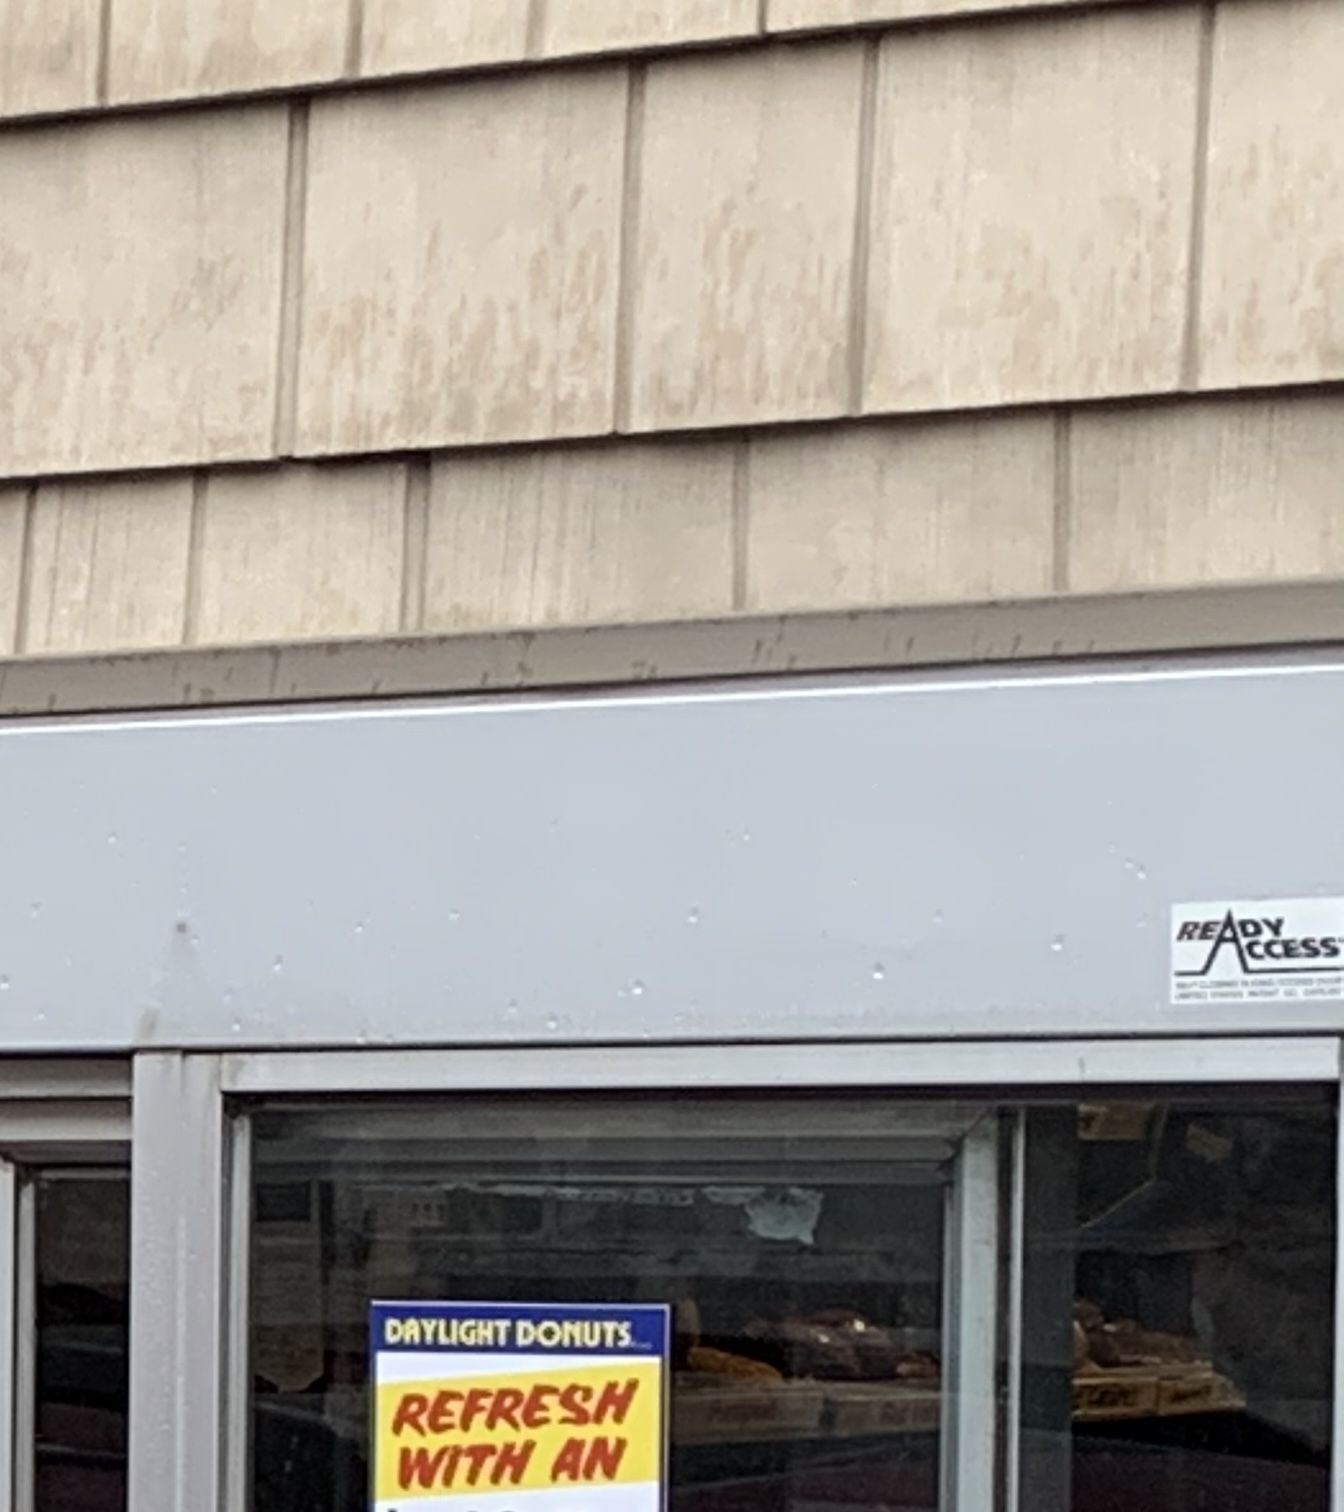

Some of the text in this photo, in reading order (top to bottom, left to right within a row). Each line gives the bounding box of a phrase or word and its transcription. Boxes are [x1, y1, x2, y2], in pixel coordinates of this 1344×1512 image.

[1176, 908, 1284, 960] READY
[384, 1317, 633, 1348] DAYLIGHT DONUTS
[391, 1378, 640, 1437] REFRESH
[396, 1436, 628, 1491] WITH AN
